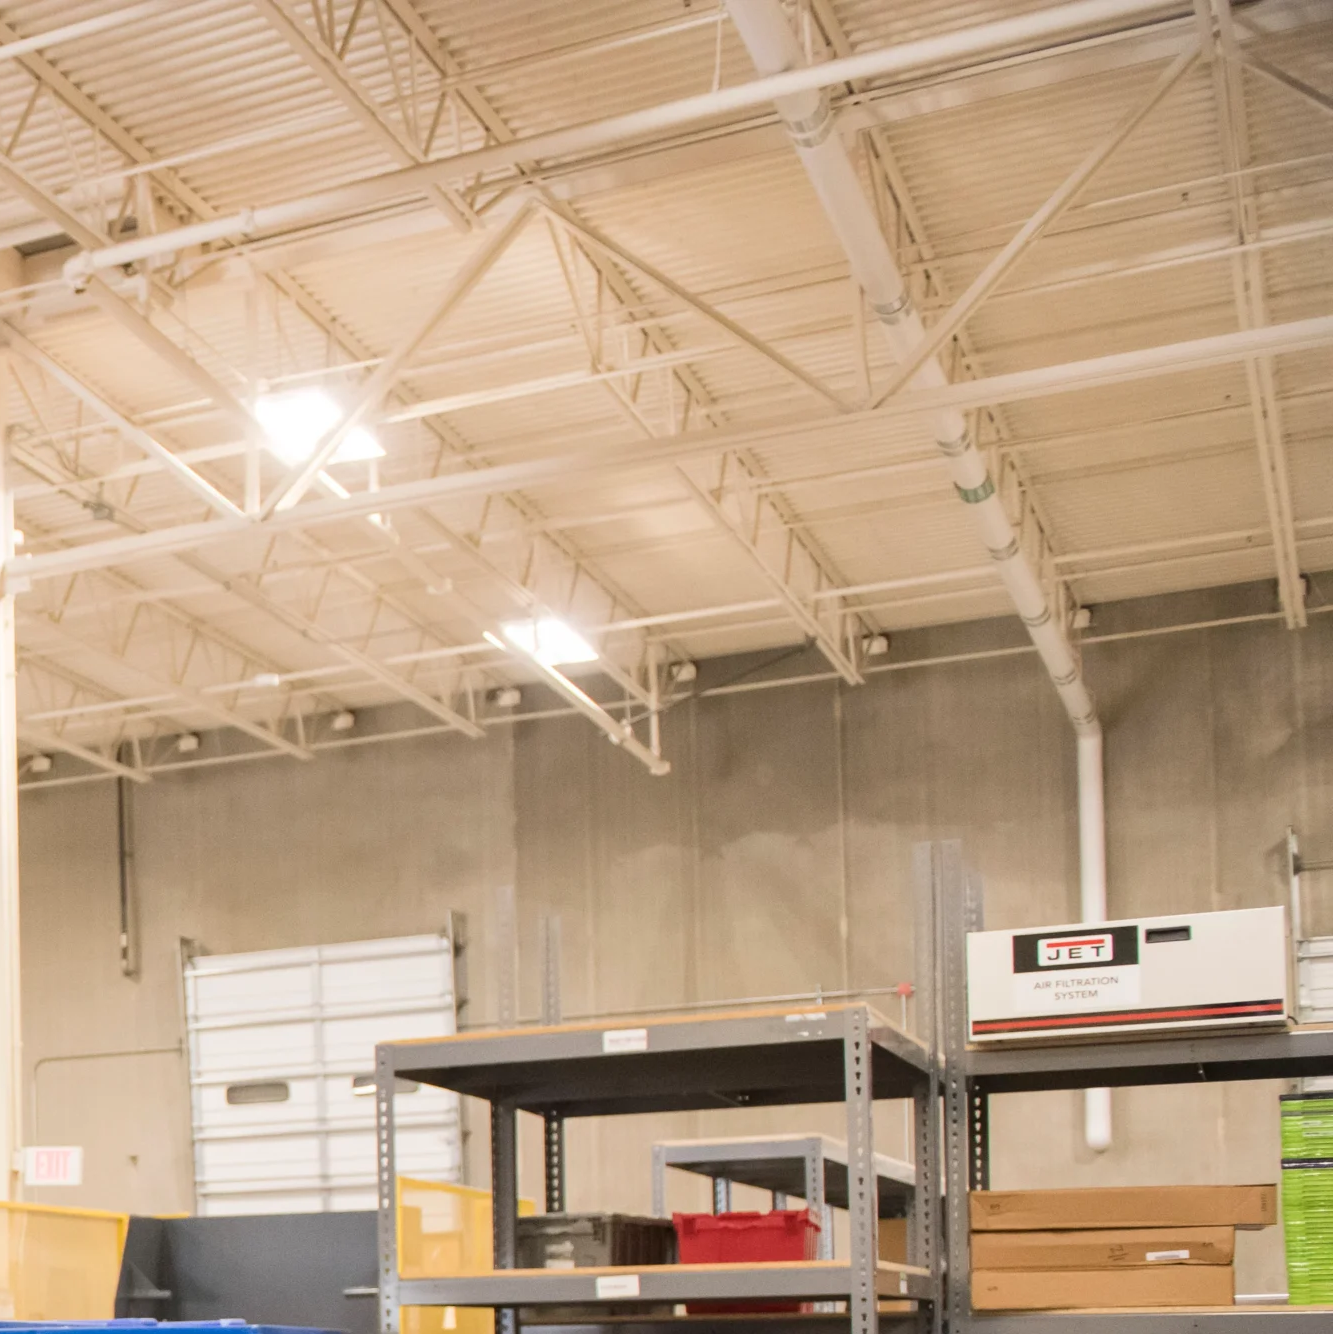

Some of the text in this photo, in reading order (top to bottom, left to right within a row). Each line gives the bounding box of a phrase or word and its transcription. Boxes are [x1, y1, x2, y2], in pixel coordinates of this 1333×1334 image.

[1047, 945, 1105, 960] JET
[1034, 976, 1119, 990] AIR FILTRATION
[1055, 990, 1098, 1000] SYSTEM
[35, 1151, 73, 1181] EXIT
